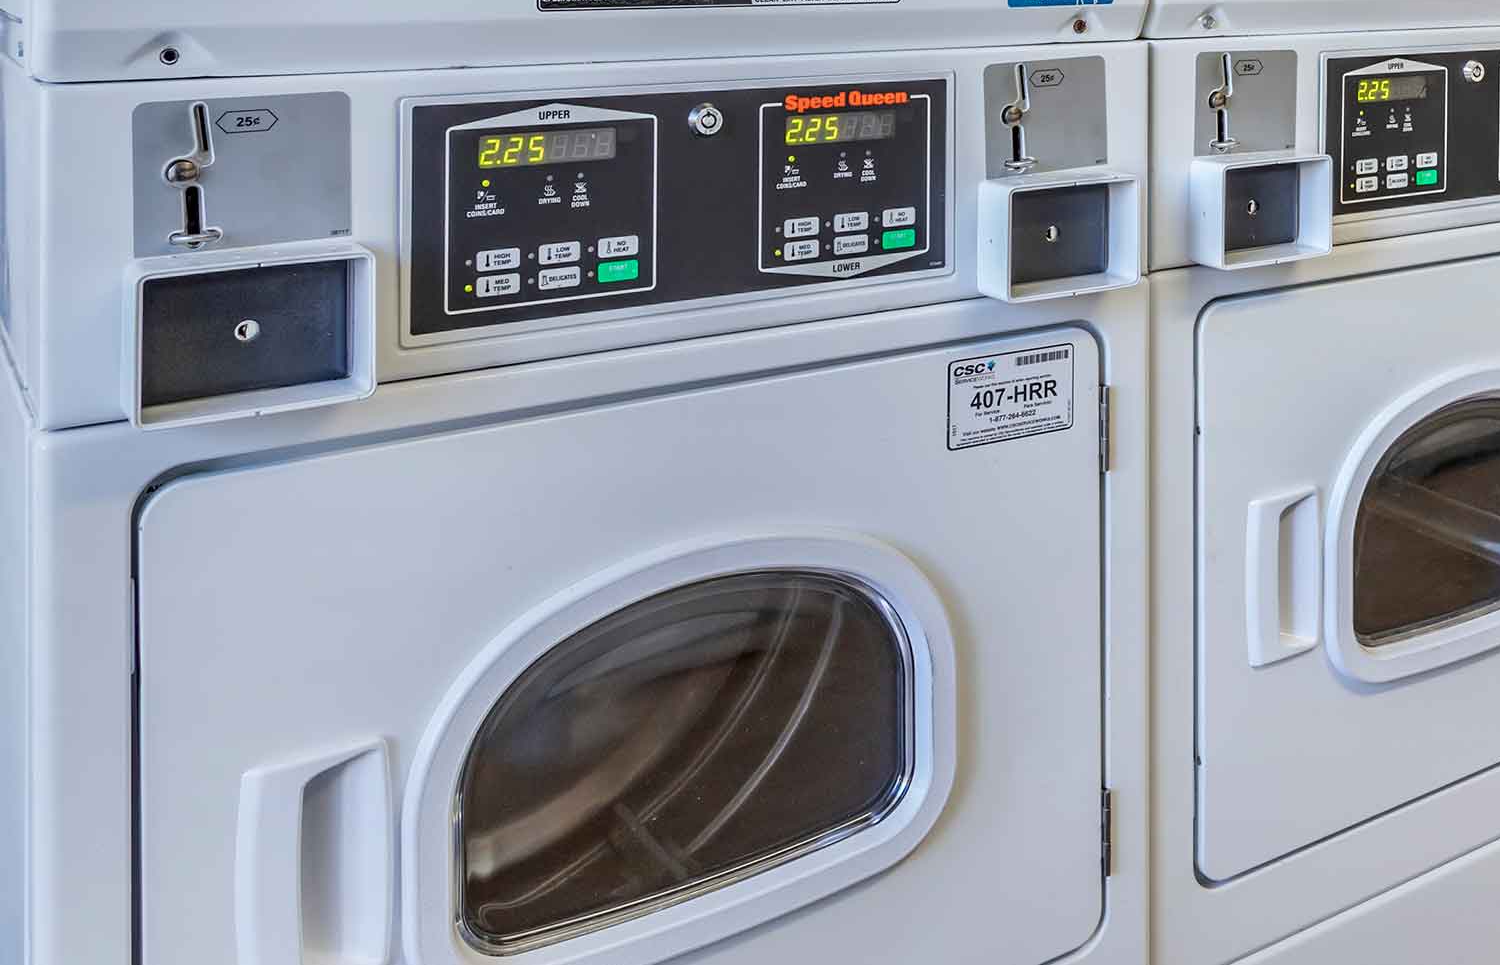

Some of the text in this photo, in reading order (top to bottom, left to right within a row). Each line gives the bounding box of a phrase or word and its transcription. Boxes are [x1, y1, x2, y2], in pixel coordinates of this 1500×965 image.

[1358, 80, 1389, 101] 2.25
[785, 91, 909, 111] Speed Queen
[539, 110, 570, 121] UPPER
[236, 116, 261, 128] 25¢
[785, 117, 838, 144] 2.25
[480, 135, 545, 166] 2.25
[538, 197, 561, 205] DRYING
[466, 209, 505, 218] COINS/CARD
[555, 252, 572, 260] TEMP
[832, 262, 861, 273] LOWER
[548, 273, 577, 282] DELICATES
[493, 284, 511, 292] TEMP
[954, 363, 985, 377] CSC
[970, 380, 1058, 410] 407-HRR
